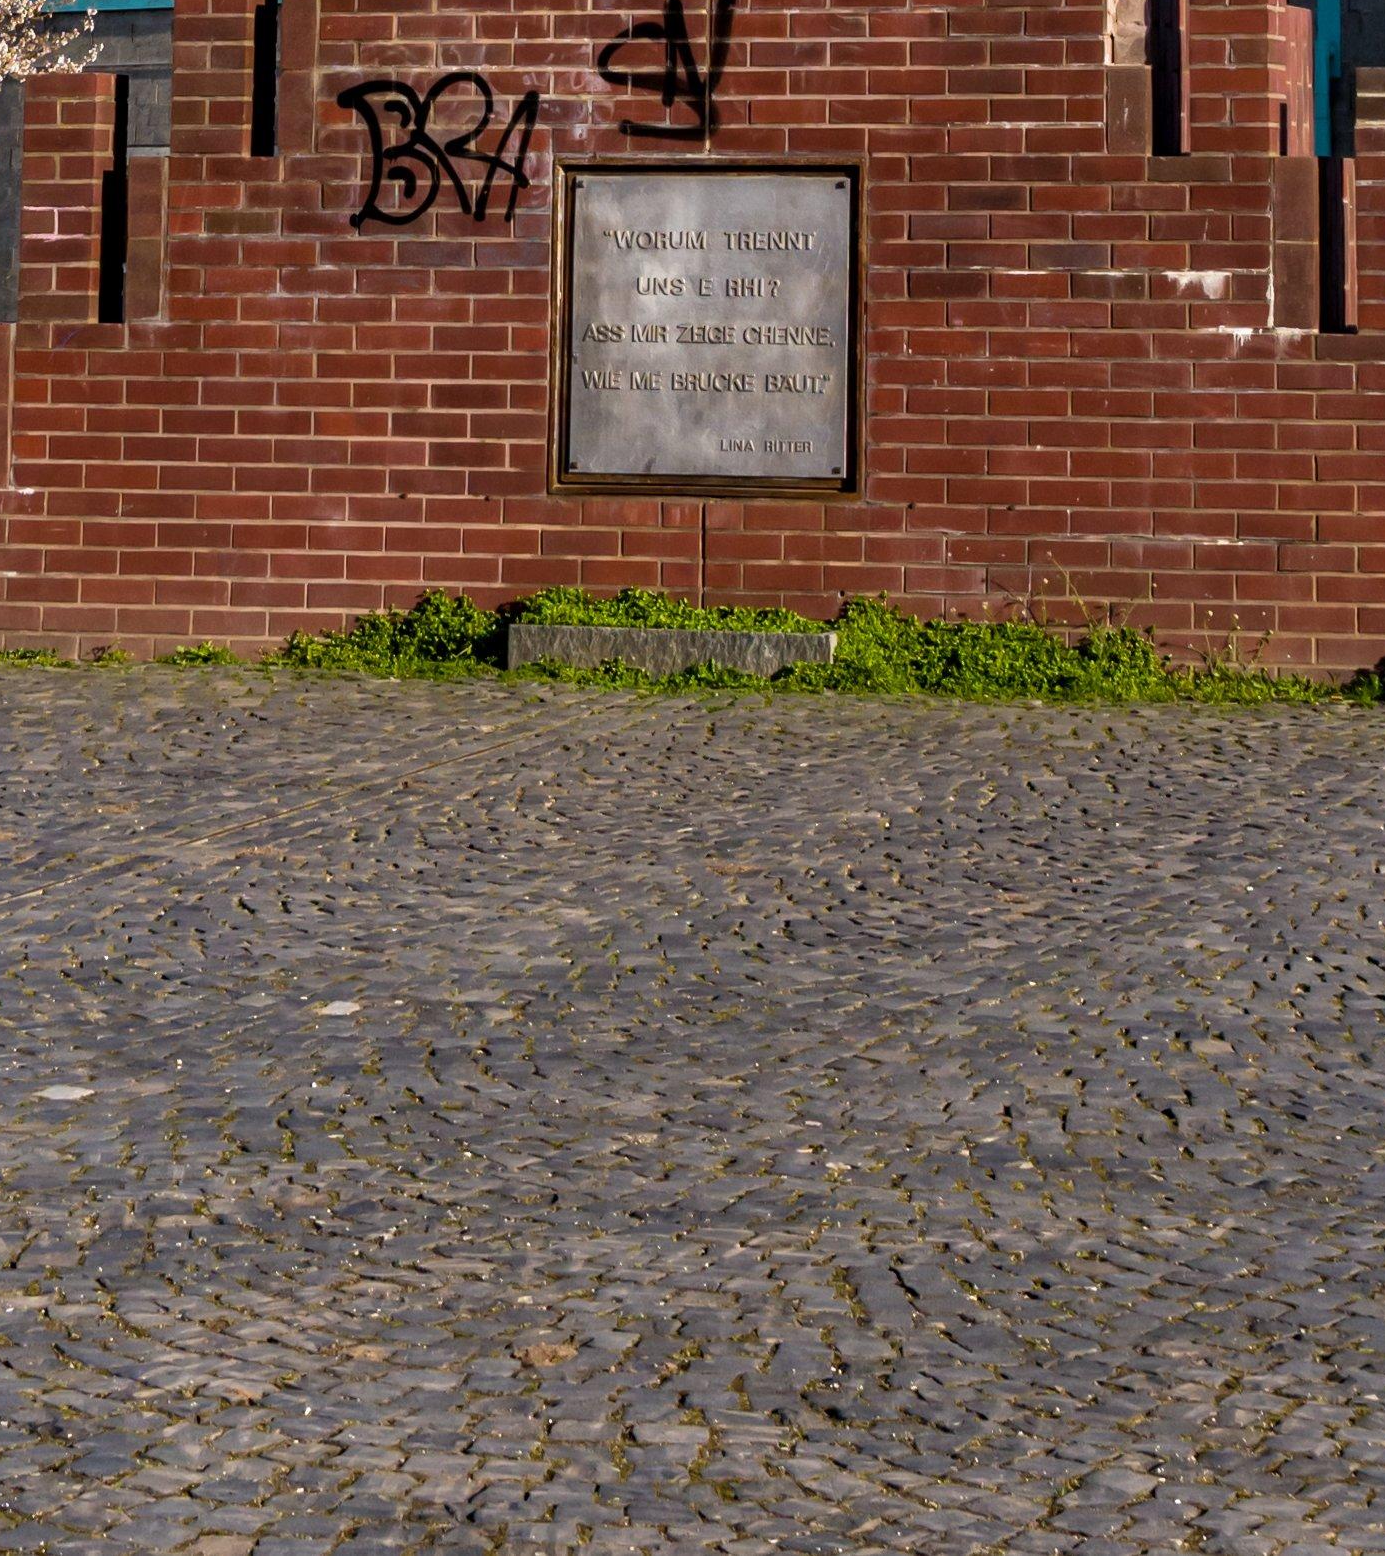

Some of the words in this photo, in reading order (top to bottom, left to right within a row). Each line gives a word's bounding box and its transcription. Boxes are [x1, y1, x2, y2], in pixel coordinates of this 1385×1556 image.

[724, 230, 817, 251] TRENNT
[636, 277, 686, 296] UNS
[699, 278, 713, 297] E
[582, 323, 626, 343] ASS
[631, 323, 670, 343] MIR
[676, 323, 737, 345] ZEIGE
[582, 370, 622, 390] WIE
[630, 370, 663, 391] ME
[720, 438, 755, 453] LINA
[765, 439, 813, 454] RITTER
